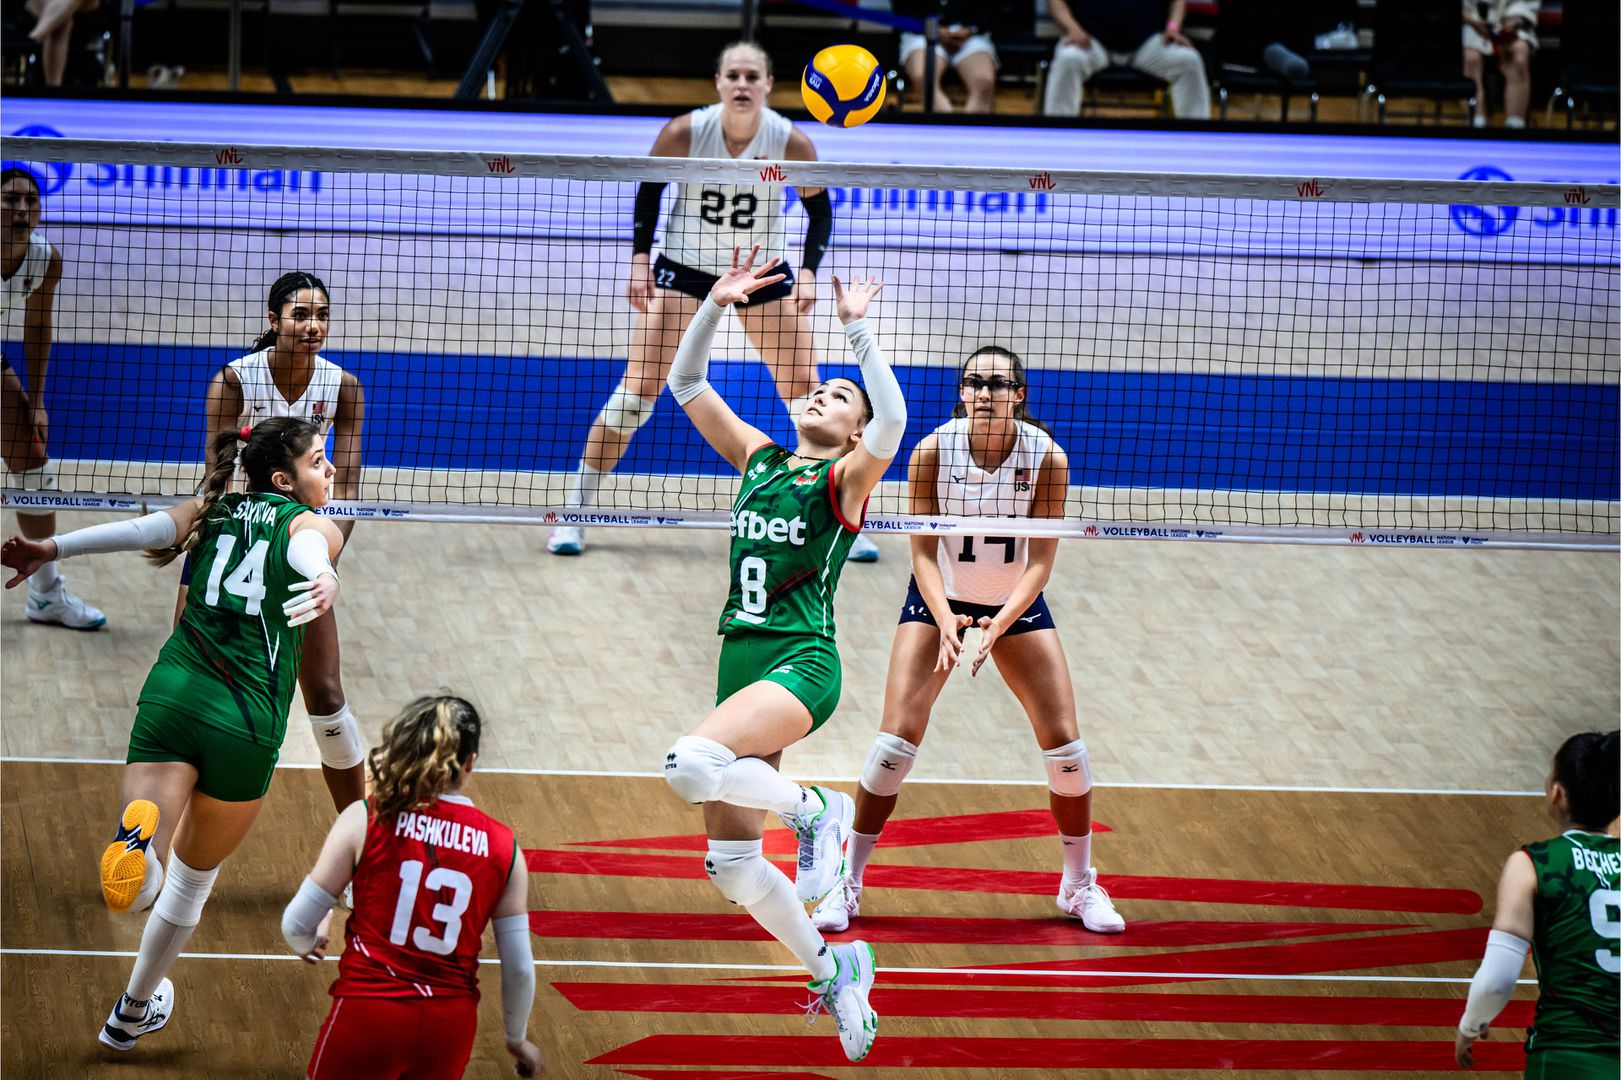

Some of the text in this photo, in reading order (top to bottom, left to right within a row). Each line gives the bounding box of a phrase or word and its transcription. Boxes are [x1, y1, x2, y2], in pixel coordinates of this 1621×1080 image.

[216, 146, 243, 165] VNL
[488, 154, 515, 174] VNL
[760, 164, 787, 182] VNL
[1029, 171, 1056, 190] VNL
[1297, 179, 1324, 198] VNL
[1564, 186, 1591, 205] VNL
[701, 190, 757, 229] 22
[657, 267, 676, 288] 22
[13, 495, 81, 507] VOLLEYBALL
[315, 506, 355, 516] EYBALL
[543, 511, 630, 524] VNL VOLLEYBALL
[730, 510, 806, 546] efbet
[864, 520, 902, 530] EYBALL
[1083, 525, 1169, 537] VNL VOLLEYBALL
[1350, 532, 1435, 544] VNL VOLLEYBALL
[205, 534, 270, 616] 14
[740, 556, 767, 614] 8
[395, 811, 489, 858] PASHKULEVA
[1571, 847, 1620, 876] BECHE
[389, 859, 473, 956] 13
[1589, 888, 1620, 973] 9
